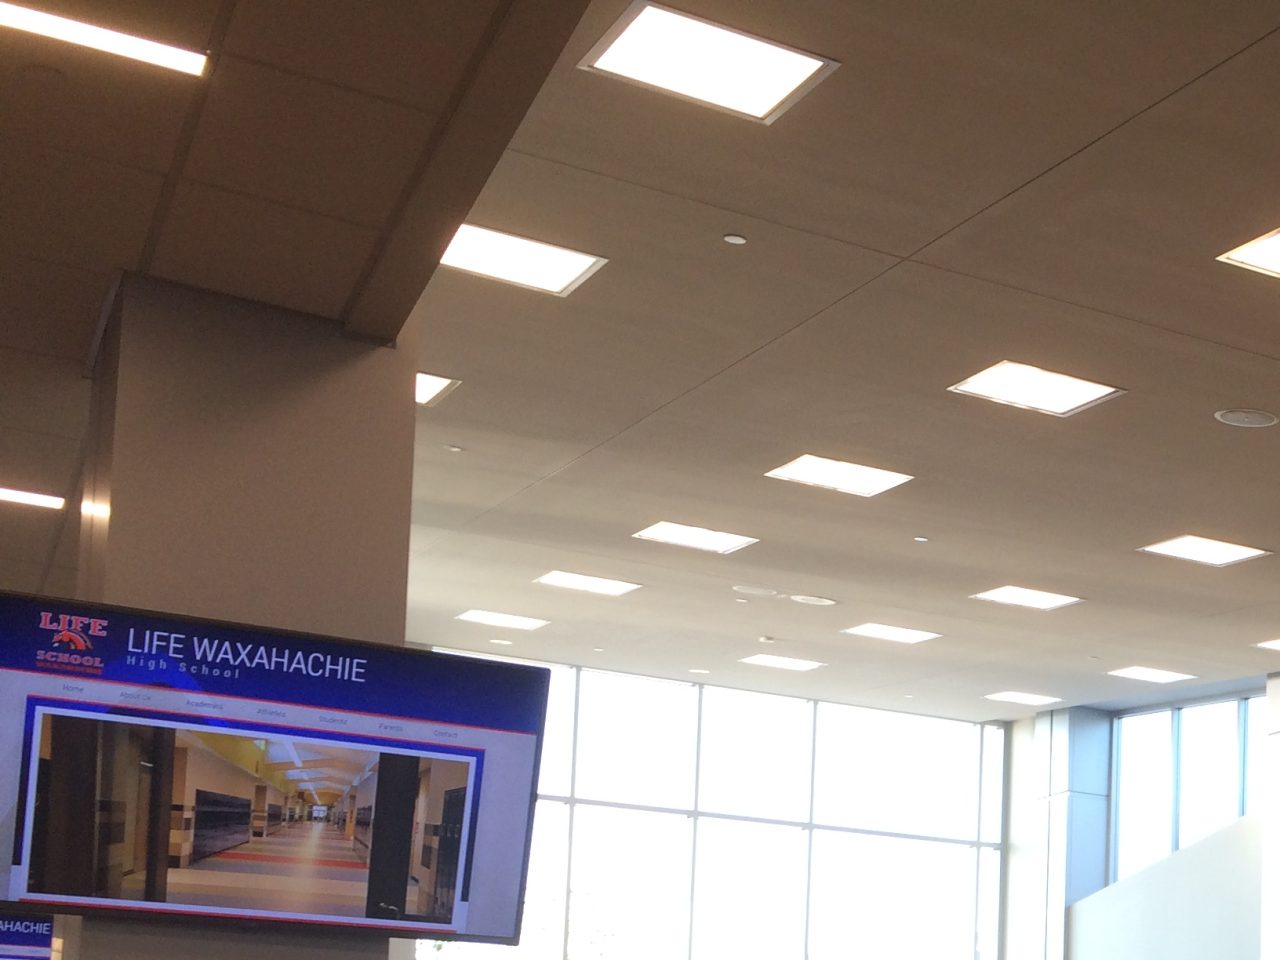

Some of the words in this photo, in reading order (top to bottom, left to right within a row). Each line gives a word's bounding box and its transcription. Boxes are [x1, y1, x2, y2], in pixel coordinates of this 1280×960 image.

[39, 612, 109, 637] LIFE
[36, 650, 104, 667] SCHOOL
[127, 628, 186, 659] LIFE
[193, 636, 367, 682] WAXAHACHIE
[126, 656, 167, 670] High
[178, 662, 240, 679] School
